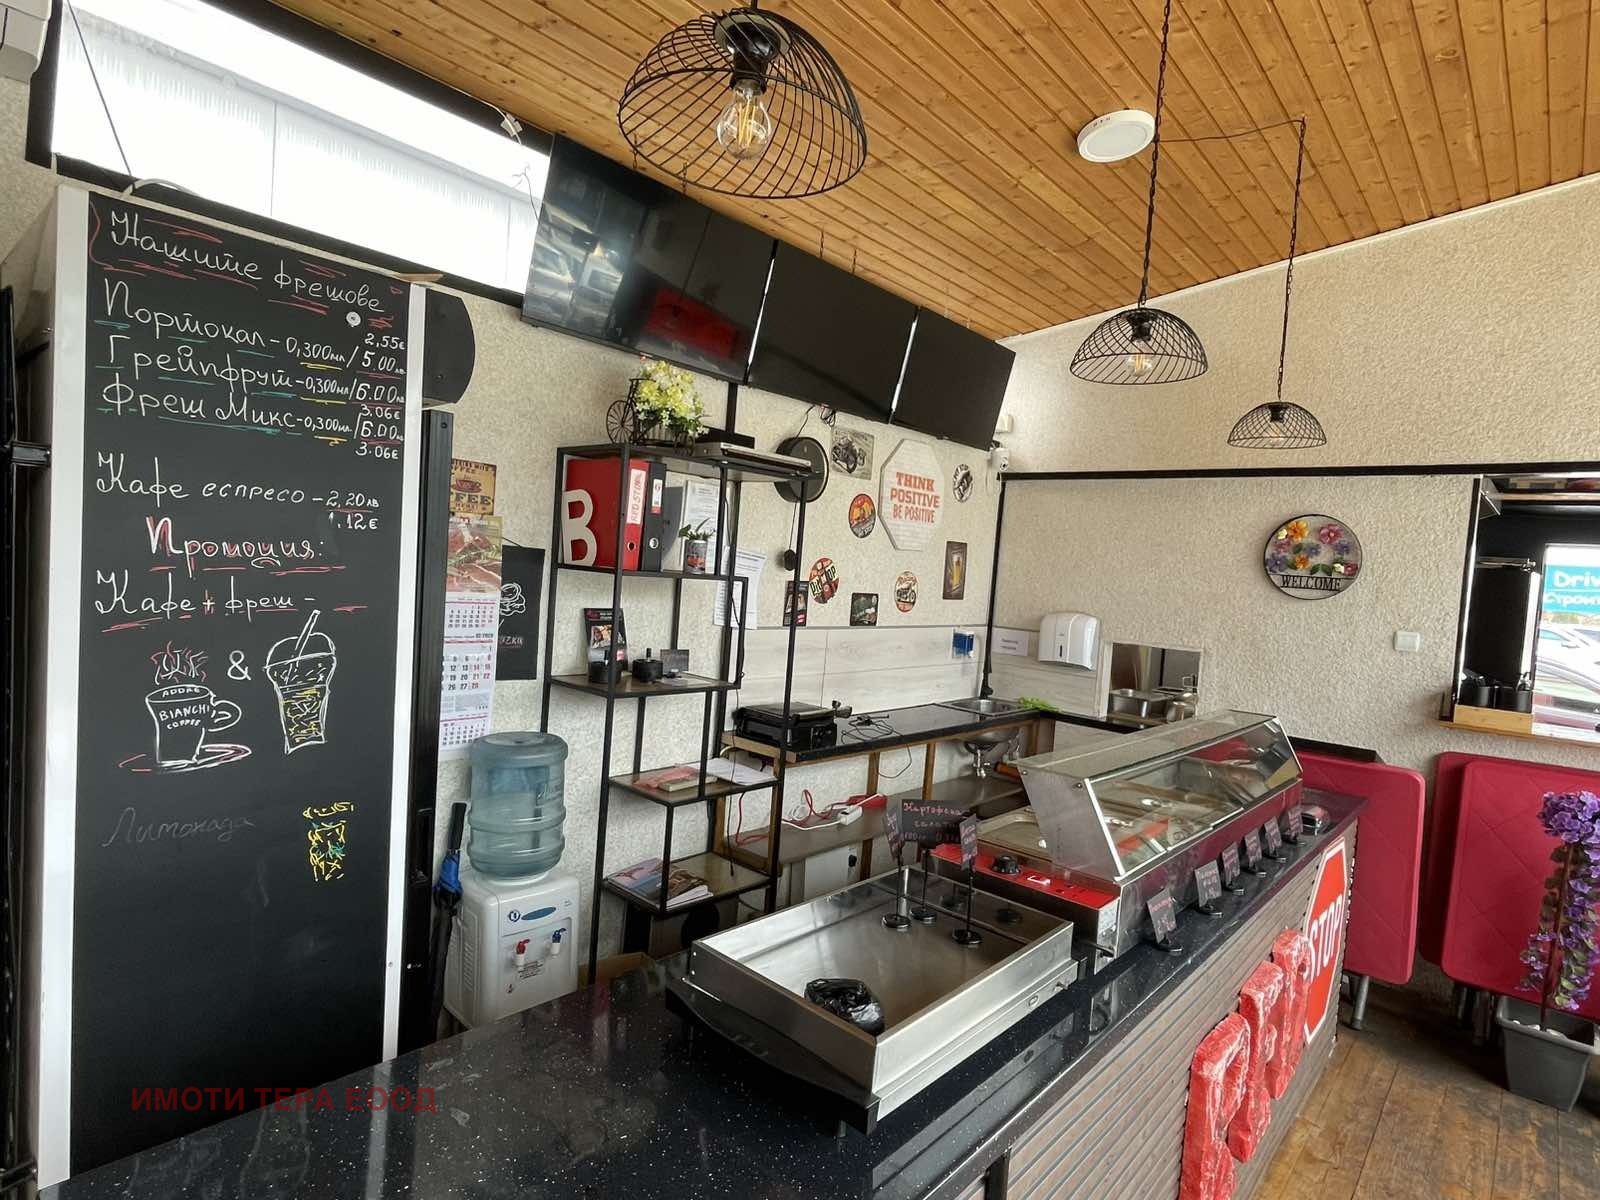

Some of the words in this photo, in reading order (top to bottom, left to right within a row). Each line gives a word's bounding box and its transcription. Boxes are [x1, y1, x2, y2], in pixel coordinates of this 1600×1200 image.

[96, 452, 190, 508] Кафе
[202, 480, 305, 504] еспресо
[896, 472, 935, 492] THINK
[890, 488, 940, 508] POSITIVE
[893, 504, 903, 519] BE
[905, 506, 935, 523] POSITIVE
[1281, 575, 1341, 591] WELCOME
[95, 569, 197, 620] Кафе
